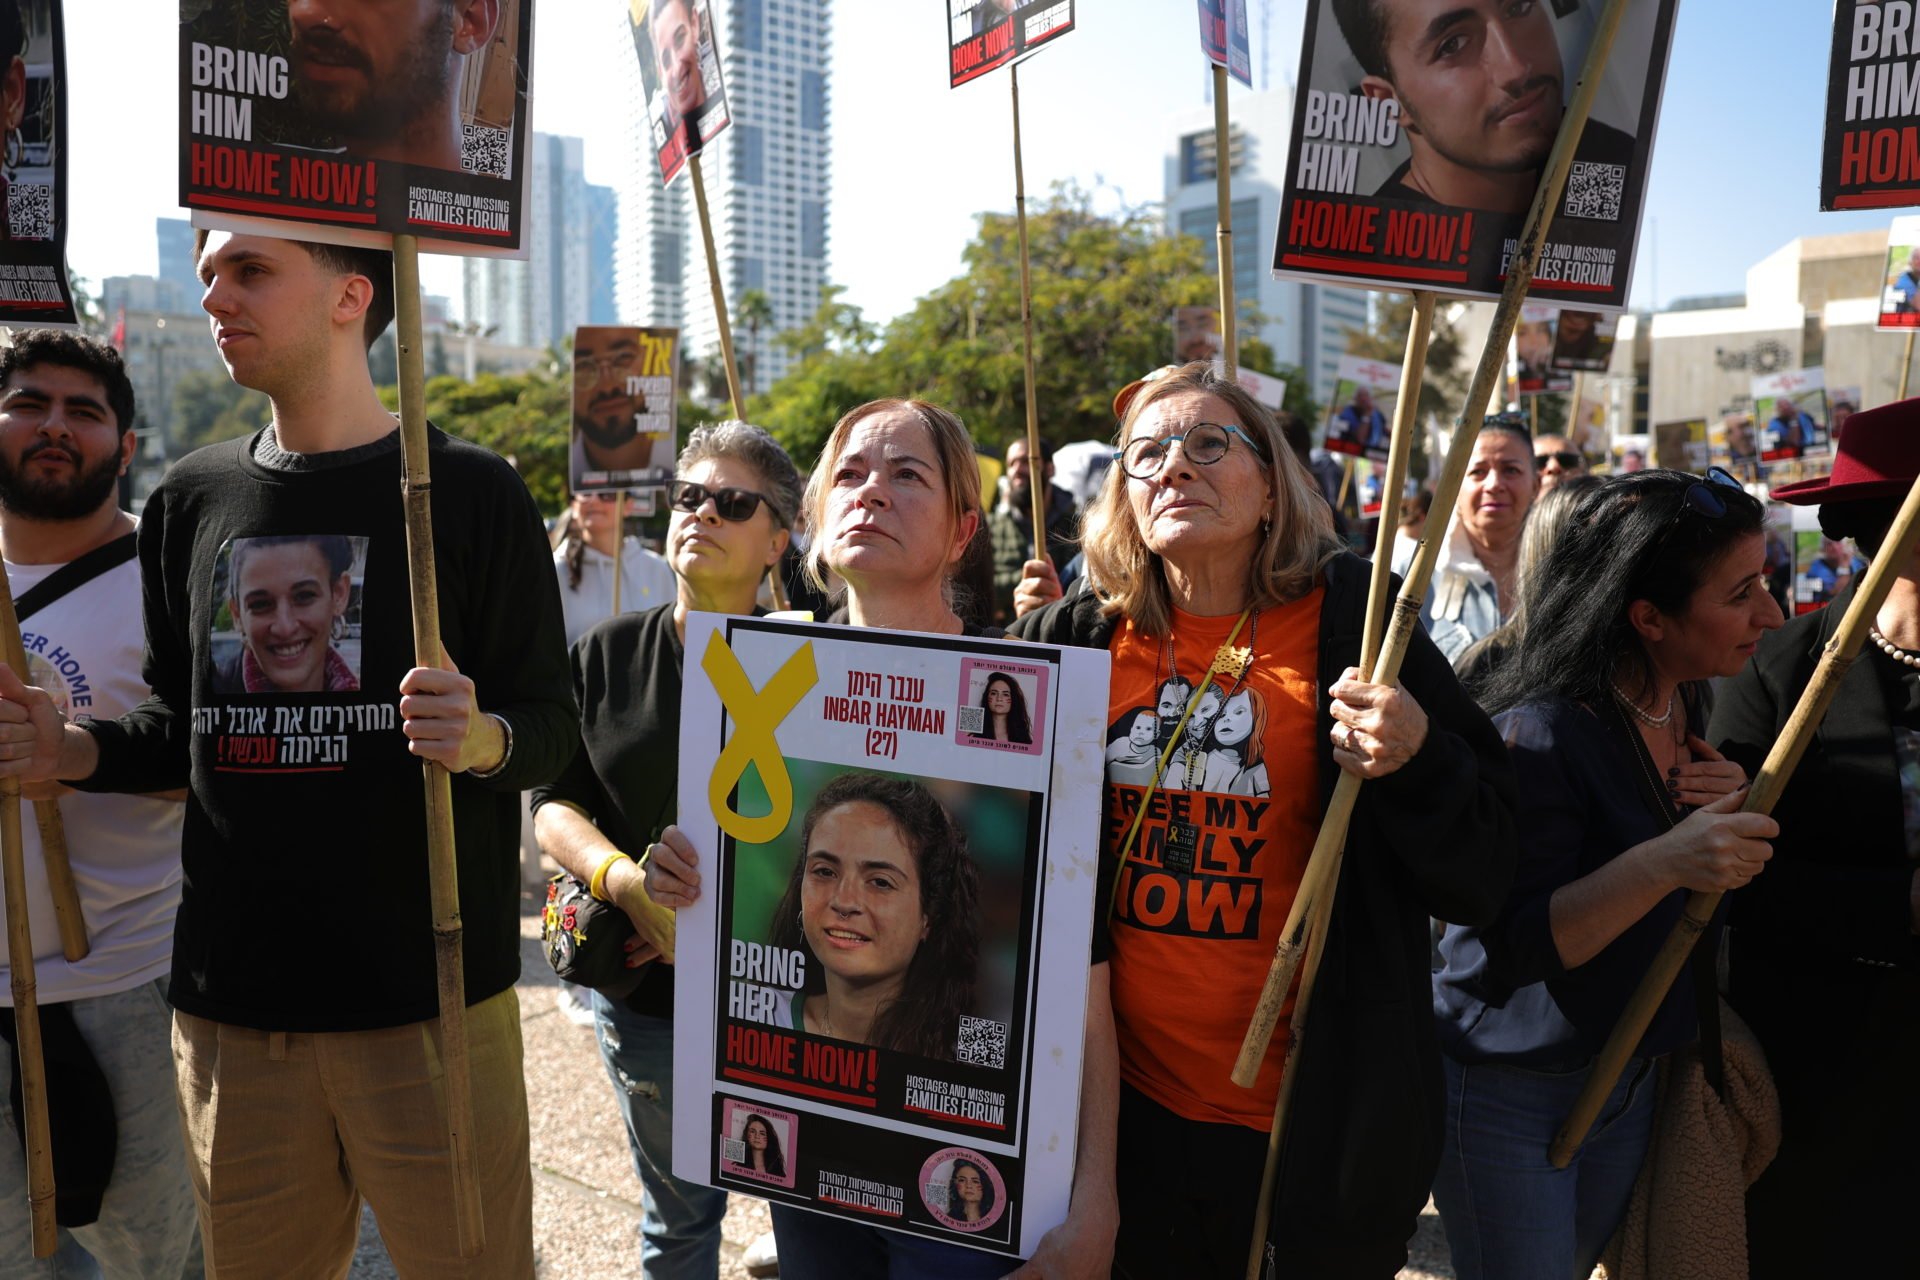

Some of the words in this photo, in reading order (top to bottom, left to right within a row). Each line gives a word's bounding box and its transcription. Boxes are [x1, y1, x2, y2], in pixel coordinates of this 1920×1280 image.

[953, 37, 983, 74] HOME
[985, 15, 1015, 60] NOW!
[192, 41, 289, 99] BRING
[1845, 60, 1920, 122] HIM
[192, 90, 252, 142] HIM
[1303, 89, 1400, 147] BRING
[192, 142, 281, 196] HOME
[289, 156, 377, 208] NOW!
[1296, 142, 1360, 195] HIM
[408, 199, 464, 226] FAMILIES
[466, 208, 509, 232] FORUM
[409, 186, 453, 205] HOSTAGES
[454, 193, 471, 208] AND
[472, 196, 510, 213] MISSING
[1288, 199, 1380, 254] HOME
[1384, 208, 1473, 265] NOW!
[1503, 238, 1552, 258] HOES
[1552, 243, 1572, 260] AND
[1572, 245, 1617, 264] MISSING
[1500, 254, 1562, 281] FLIES
[1563, 261, 1614, 287] FORUM
[29, 281, 64, 303] FORUM
[639, 332, 673, 376] אל
[22, 632, 49, 654] ER
[47, 646, 92, 708] HOME
[847, 670, 882, 698] הימן
[886, 675, 925, 703] ענבר
[272, 706, 304, 734] את
[309, 703, 395, 734] מחזירים
[823, 696, 872, 726] INBAR
[875, 702, 946, 735] HAYMAN
[281, 735, 348, 764] הביתה
[865, 728, 898, 760] (27)
[1205, 796, 1271, 832] MY
[1110, 818, 1268, 874] FALY
[730, 938, 806, 989] BRING
[728, 980, 777, 1026] HER
[727, 1024, 797, 1075] HOME
[802, 1040, 878, 1093] NOW!
[905, 1088, 959, 1116] FAMILIES
[960, 1099, 1004, 1126] FORUM
[906, 1074, 948, 1095] HOSTAGES
[949, 1083, 966, 1099] AND
[967, 1087, 1006, 1107] MISSING
[818, 1182, 861, 1206] והנעדרים
[819, 1169, 847, 1187] להחזרת
[848, 1176, 886, 1196] המשפחות
[886, 1185, 904, 1200] מטה
[862, 1192, 904, 1216] החטופים
